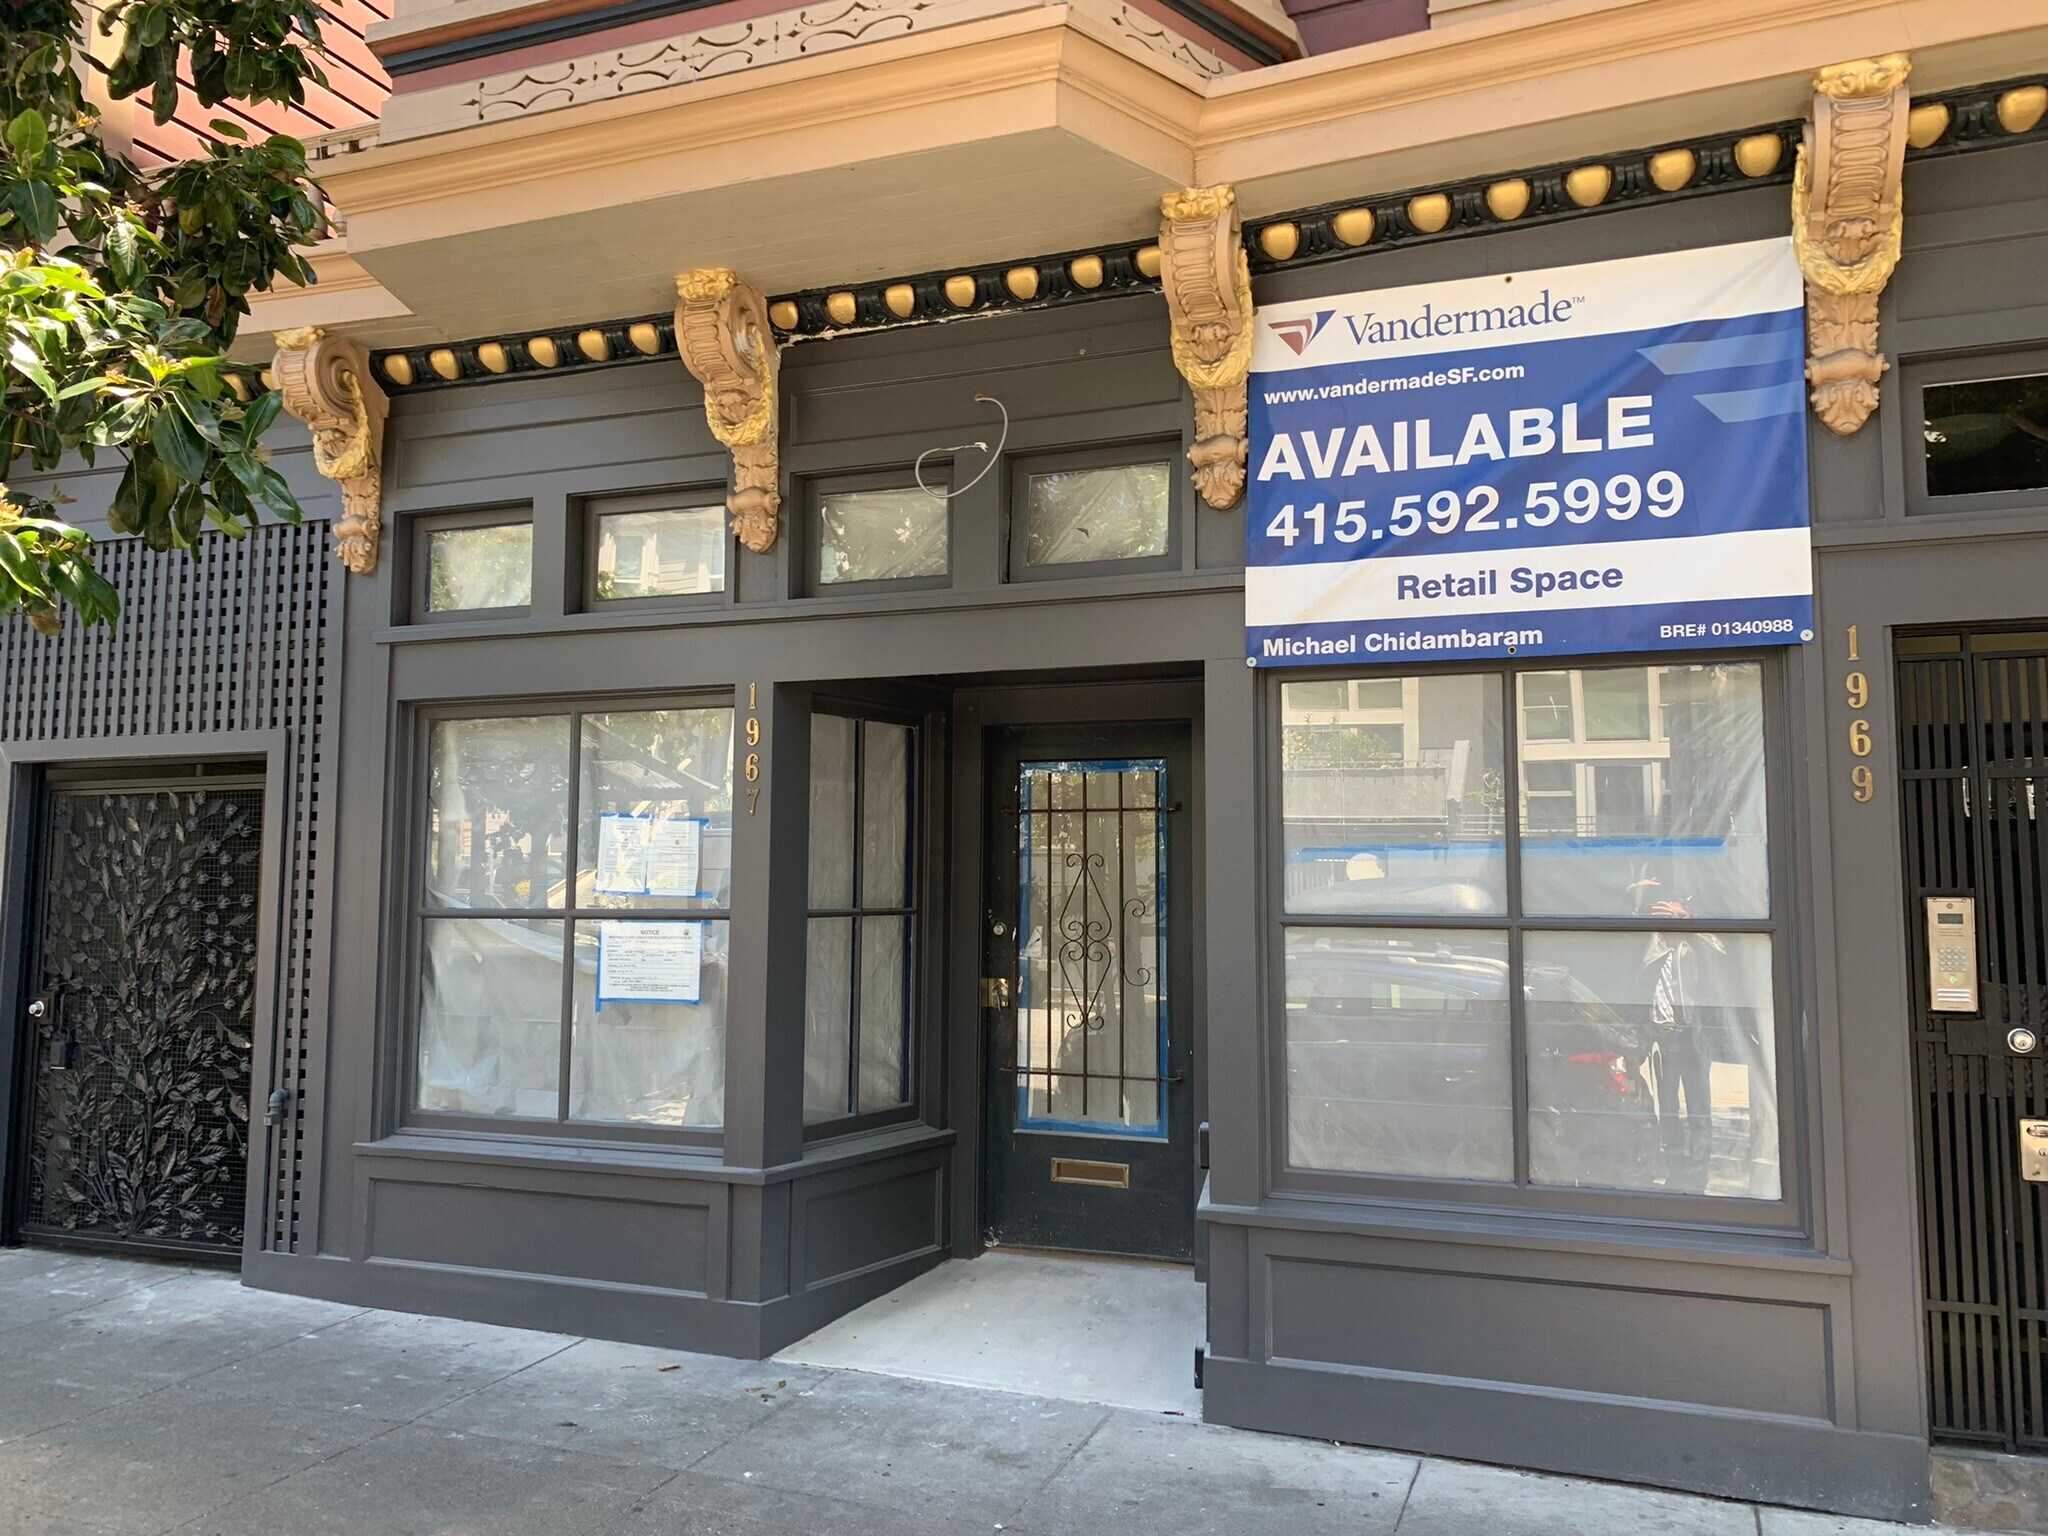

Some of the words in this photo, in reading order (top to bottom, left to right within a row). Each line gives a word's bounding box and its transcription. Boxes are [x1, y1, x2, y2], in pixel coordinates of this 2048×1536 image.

[1343, 289, 1573, 346] Vandermade
[1264, 362, 1525, 405] www.vandermadeSF.com
[1257, 394, 1655, 483] AVAILABLE
[1265, 470, 1686, 547] 415.592.5999
[1396, 569, 1498, 600] Retail
[1509, 563, 1624, 599] Space
[1262, 635, 1357, 657] Michael
[1364, 627, 1544, 653] Chidambaram
[1660, 622, 1707, 639] BRE#
[1711, 618, 1794, 637] 01340988
[1845, 625, 1875, 803] 1969
[744, 681, 761, 817] 1967
